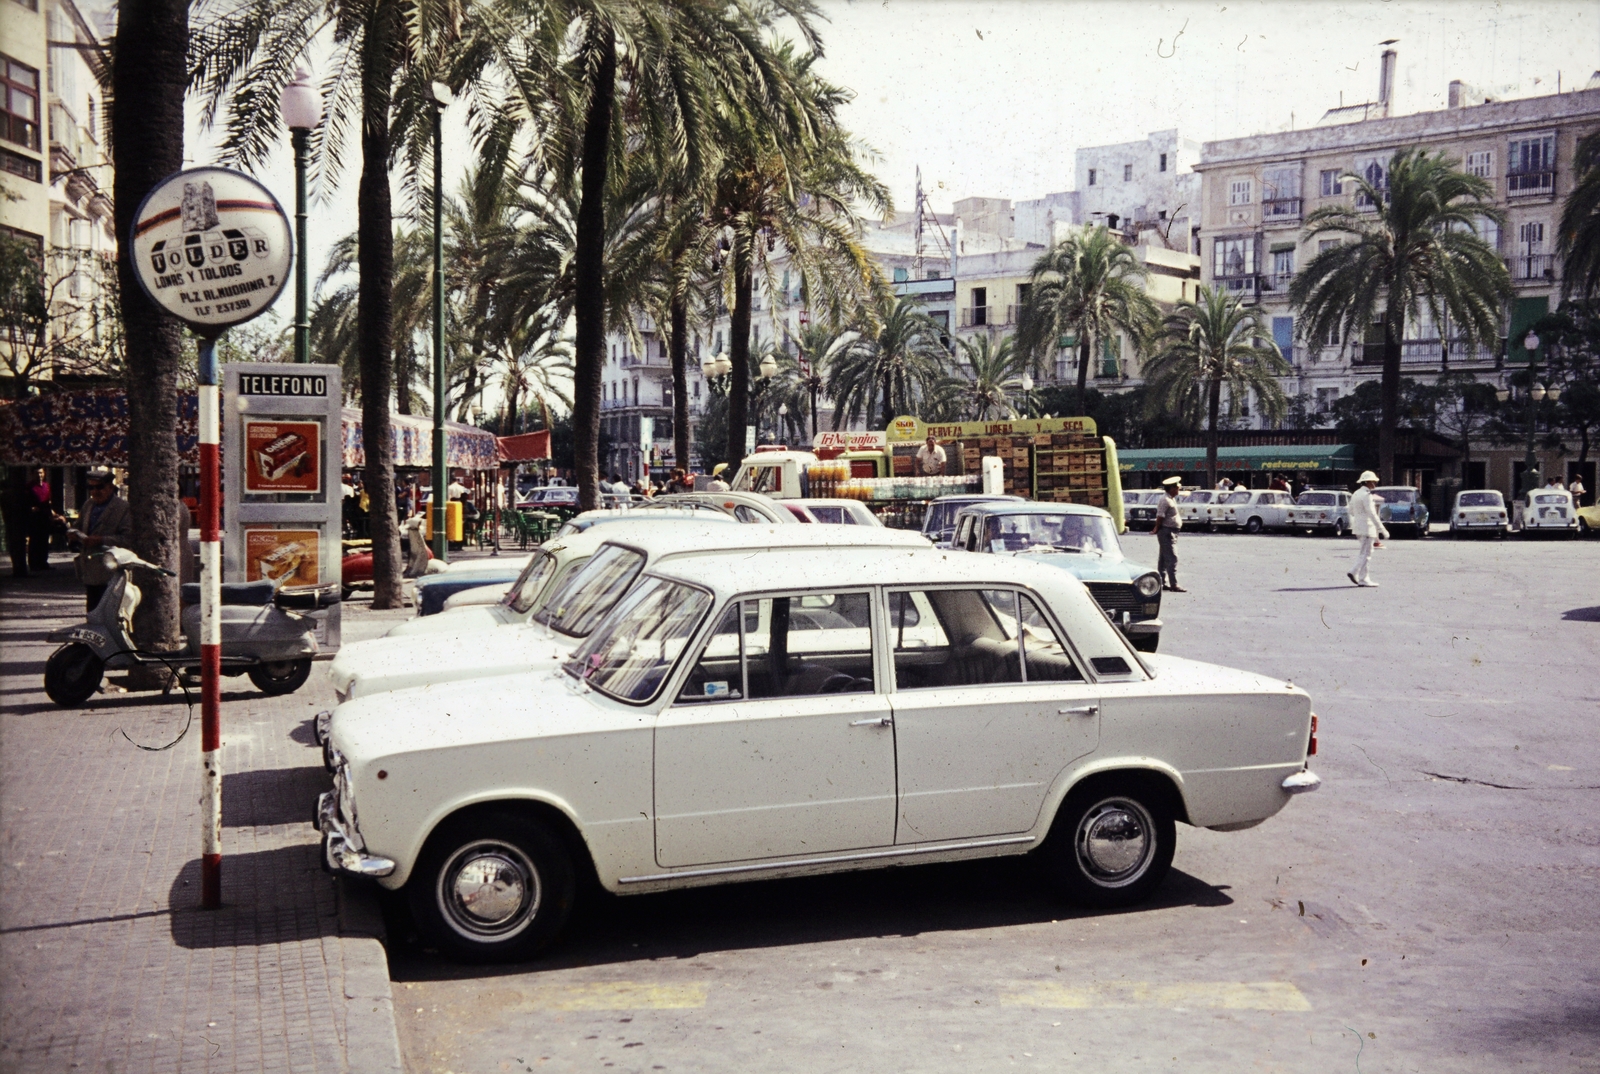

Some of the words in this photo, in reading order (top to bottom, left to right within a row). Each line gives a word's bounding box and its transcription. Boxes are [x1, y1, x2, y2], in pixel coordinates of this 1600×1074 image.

[152, 239, 269, 270] TOLDER
[154, 273, 185, 289] LONAS
[186, 271, 195, 283] Y
[198, 263, 243, 281] TOLDOS
[242, 376, 325, 395] TELEFONO
[927, 426, 963, 438] CERVEZA
[1036, 423, 1042, 433] Y
[1063, 421, 1084, 431] SECA
